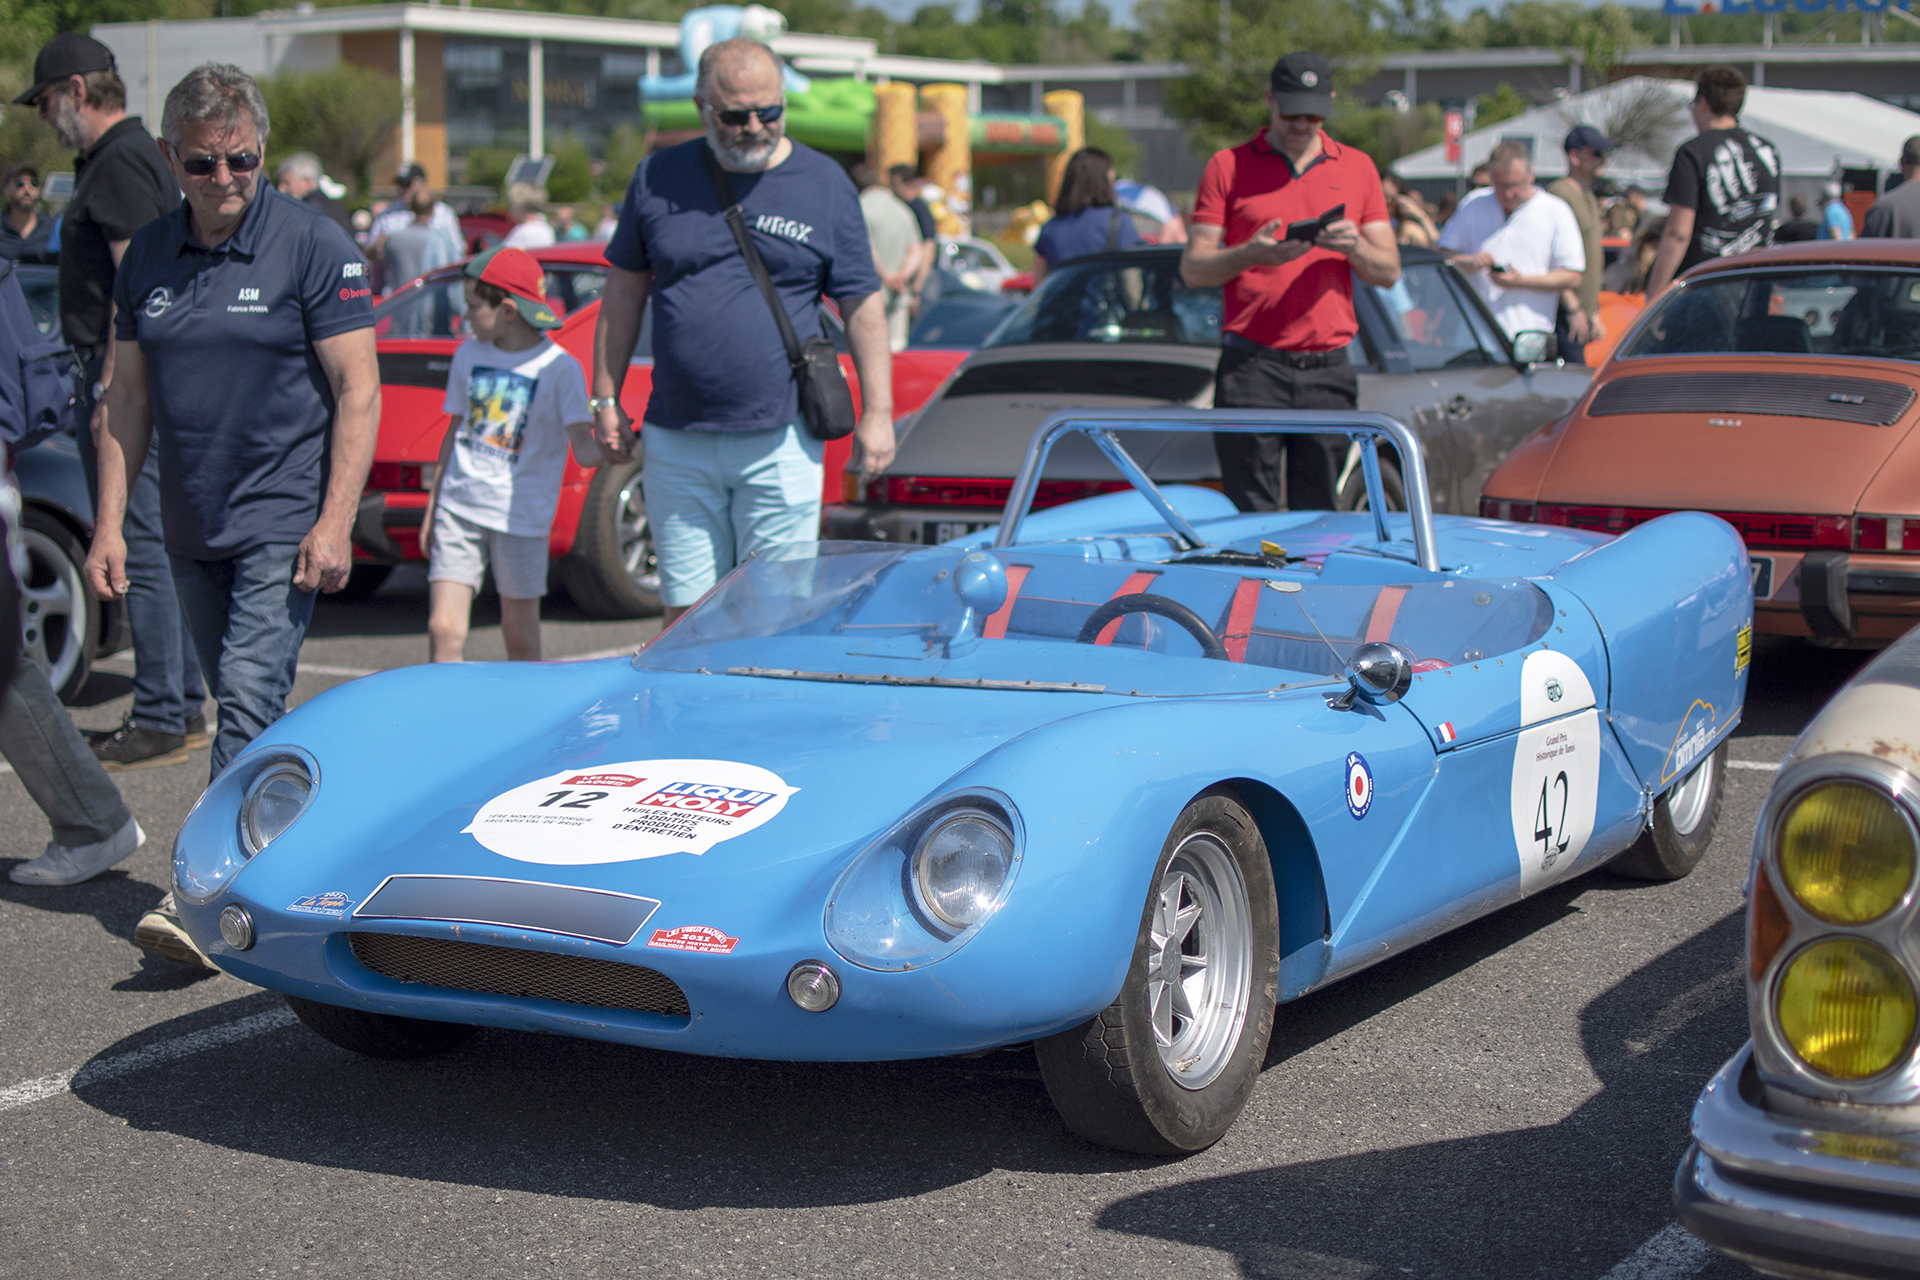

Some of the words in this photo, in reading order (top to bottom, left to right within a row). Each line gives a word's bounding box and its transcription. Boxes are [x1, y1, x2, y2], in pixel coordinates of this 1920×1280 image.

[756, 214, 814, 242] NRGX
[237, 287, 260, 301] ASM
[1546, 733, 1559, 746] Grand
[1560, 732, 1568, 742] Prix
[1536, 748, 1558, 762] Historique
[1559, 745, 1564, 755] de
[1565, 742, 1576, 753] Tunis
[538, 790, 609, 809] 12
[662, 782, 772, 805] LIQUI
[641, 793, 758, 816] MOLY
[1534, 770, 1570, 854] 42
[545, 815, 594, 823] HISTORIQUE
[622, 807, 671, 817] HUILES
[673, 811, 733, 826] MOTEURS
[640, 814, 700, 827] ADDITIFS
[611, 823, 698, 839] D'ENTRETIEN
[629, 819, 694, 832] PRODUITS
[666, 928, 679, 937] LES
[702, 927, 727, 944] BAQUETS
[680, 934, 711, 942] 2021
[686, 941, 729, 949] HISTORIQUE
